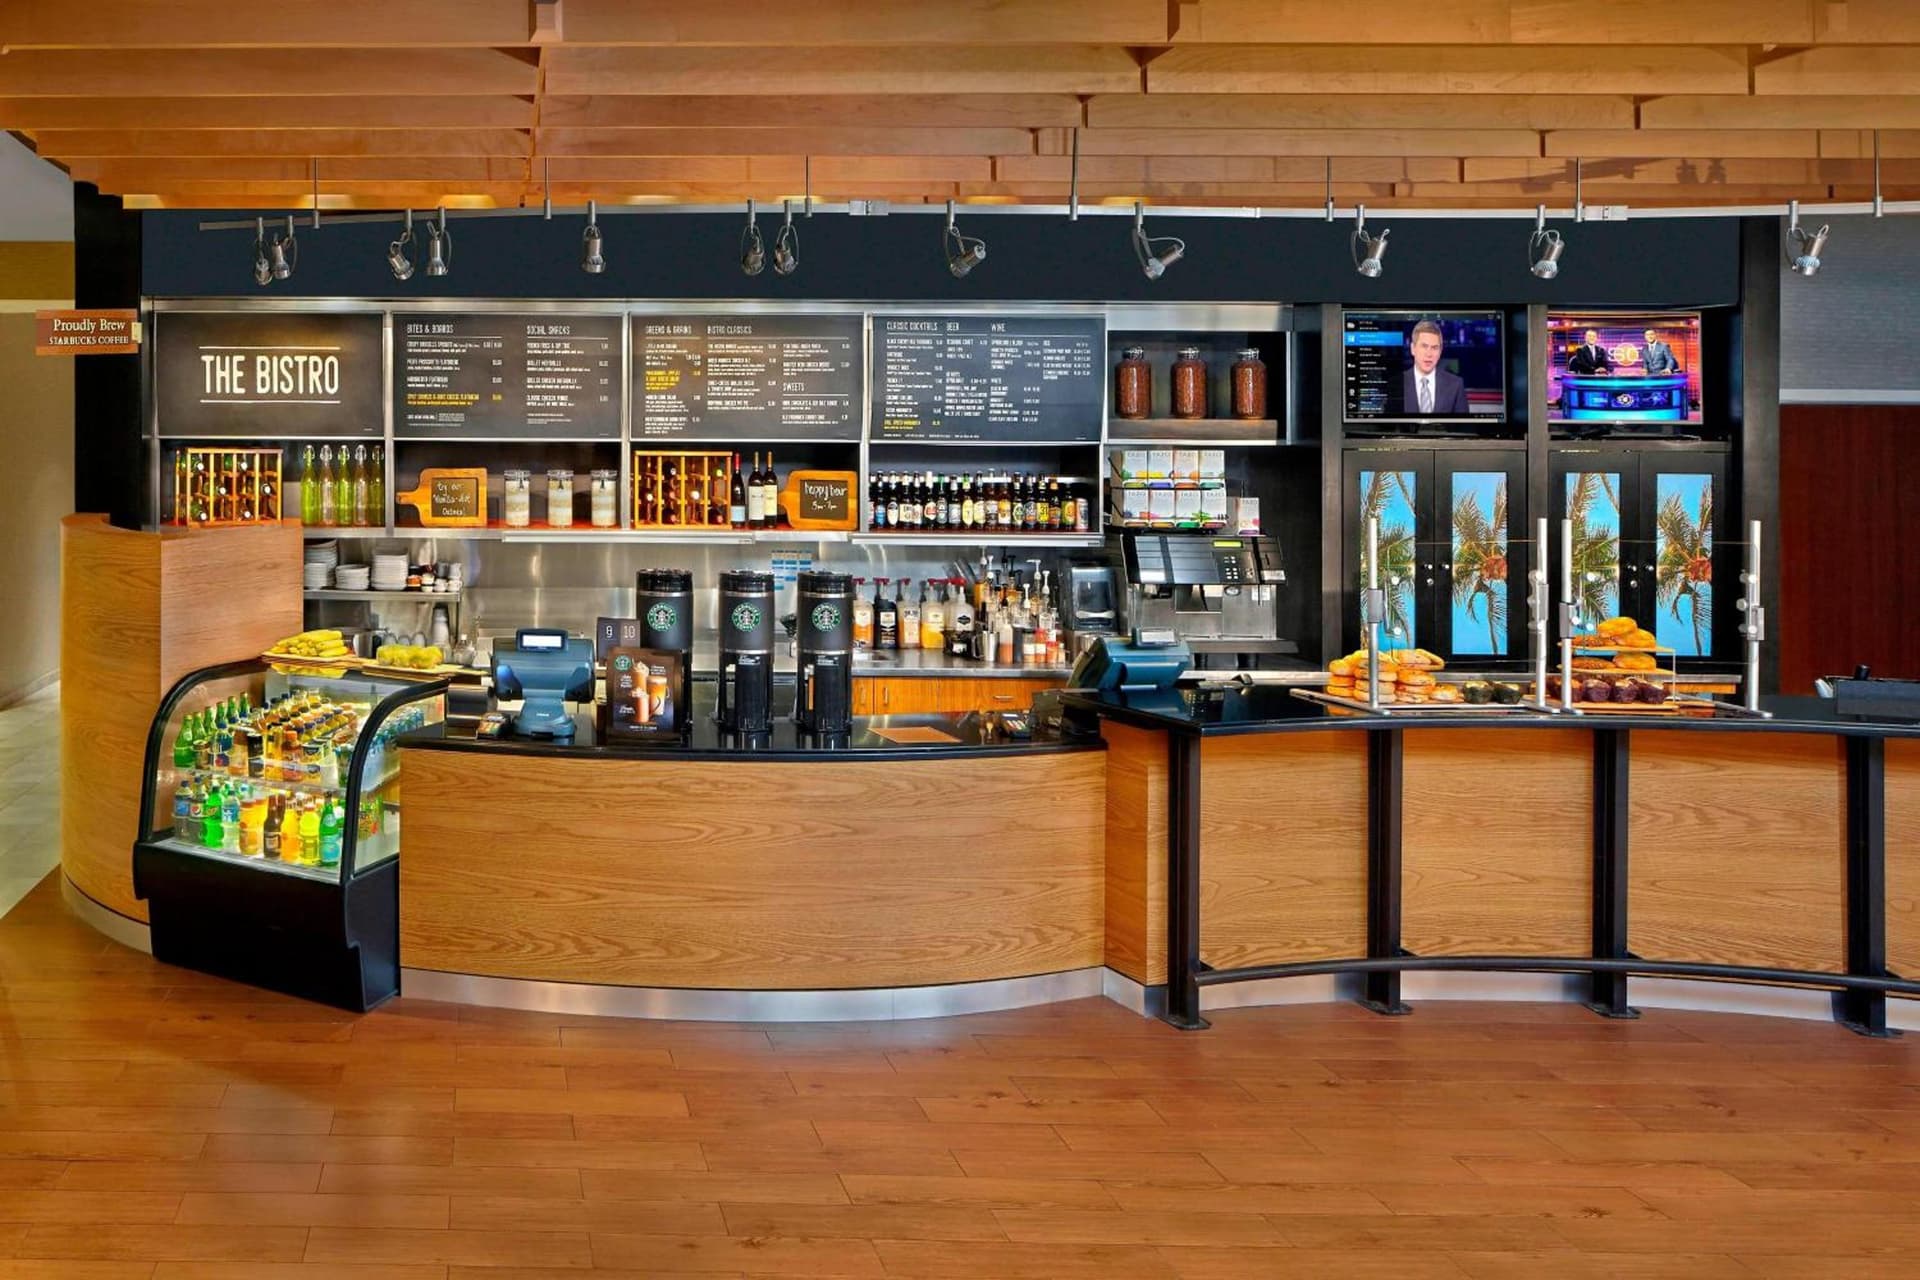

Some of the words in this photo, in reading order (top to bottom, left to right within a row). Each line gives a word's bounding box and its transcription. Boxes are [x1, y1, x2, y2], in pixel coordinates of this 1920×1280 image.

[53, 318, 96, 333] Proudly
[100, 318, 126, 331] Brew
[407, 324, 424, 334] BITES
[424, 325, 430, 334] &
[527, 325, 546, 335] SOCIAL
[548, 325, 570, 335] SNACKS
[707, 325, 725, 334] BISTRO
[726, 325, 752, 334] CLASSICS
[886, 322, 908, 331] CLASSIC
[909, 322, 938, 331] COCKTAILS
[946, 322, 959, 331] BEER
[991, 323, 1006, 331] WINE
[49, 336, 97, 345] STARBUCKS
[98, 336, 129, 345] COFFEE
[201, 355, 246, 394] THE
[256, 355, 339, 394] BISTRO
[783, 382, 805, 391] SWEETS
[804, 481, 828, 500] happy
[829, 482, 848, 496] hour
[606, 625, 613, 639] 9
[624, 625, 636, 639] 10
